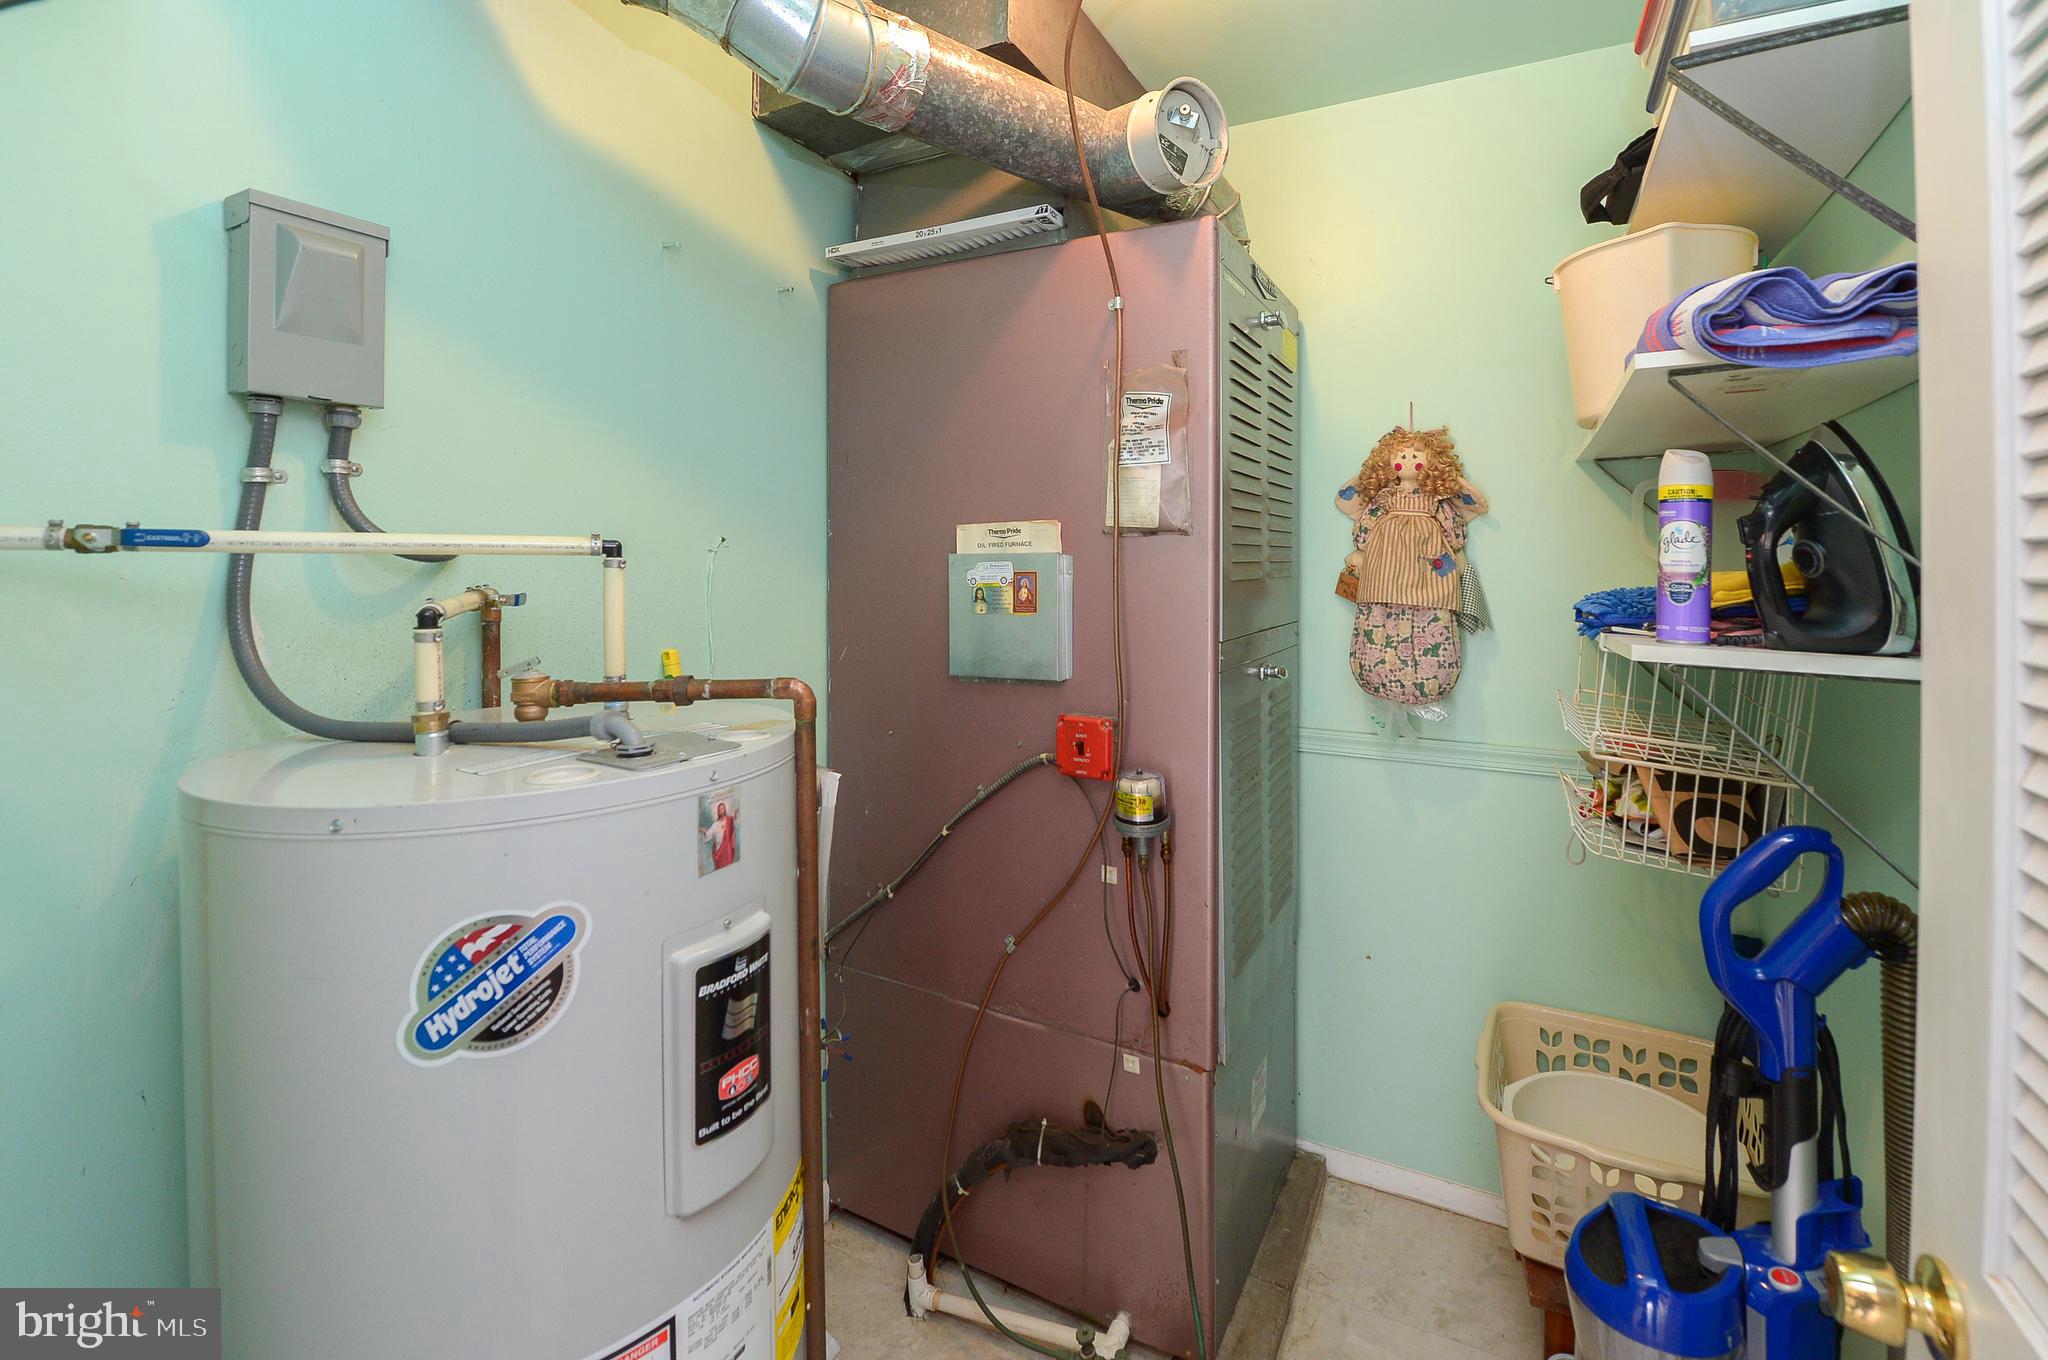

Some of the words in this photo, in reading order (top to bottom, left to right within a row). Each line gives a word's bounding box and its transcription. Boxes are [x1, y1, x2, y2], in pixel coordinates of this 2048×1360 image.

[827, 246, 840, 255] HDX
[1125, 396, 1147, 405] Thermo
[1147, 396, 1164, 405] Pride
[1007, 527, 1022, 535] Pride
[1663, 530, 1702, 554] glade
[1005, 540, 1033, 548] FURNACE
[698, 967, 749, 998] BRADFORD
[749, 952, 769, 975] WHITE
[424, 952, 525, 1043] Hydrojet
[721, 1057, 760, 1090] PHCC
[698, 1121, 720, 1138] Built
[732, 1107, 743, 1120] be
[743, 1098, 755, 1114] the
